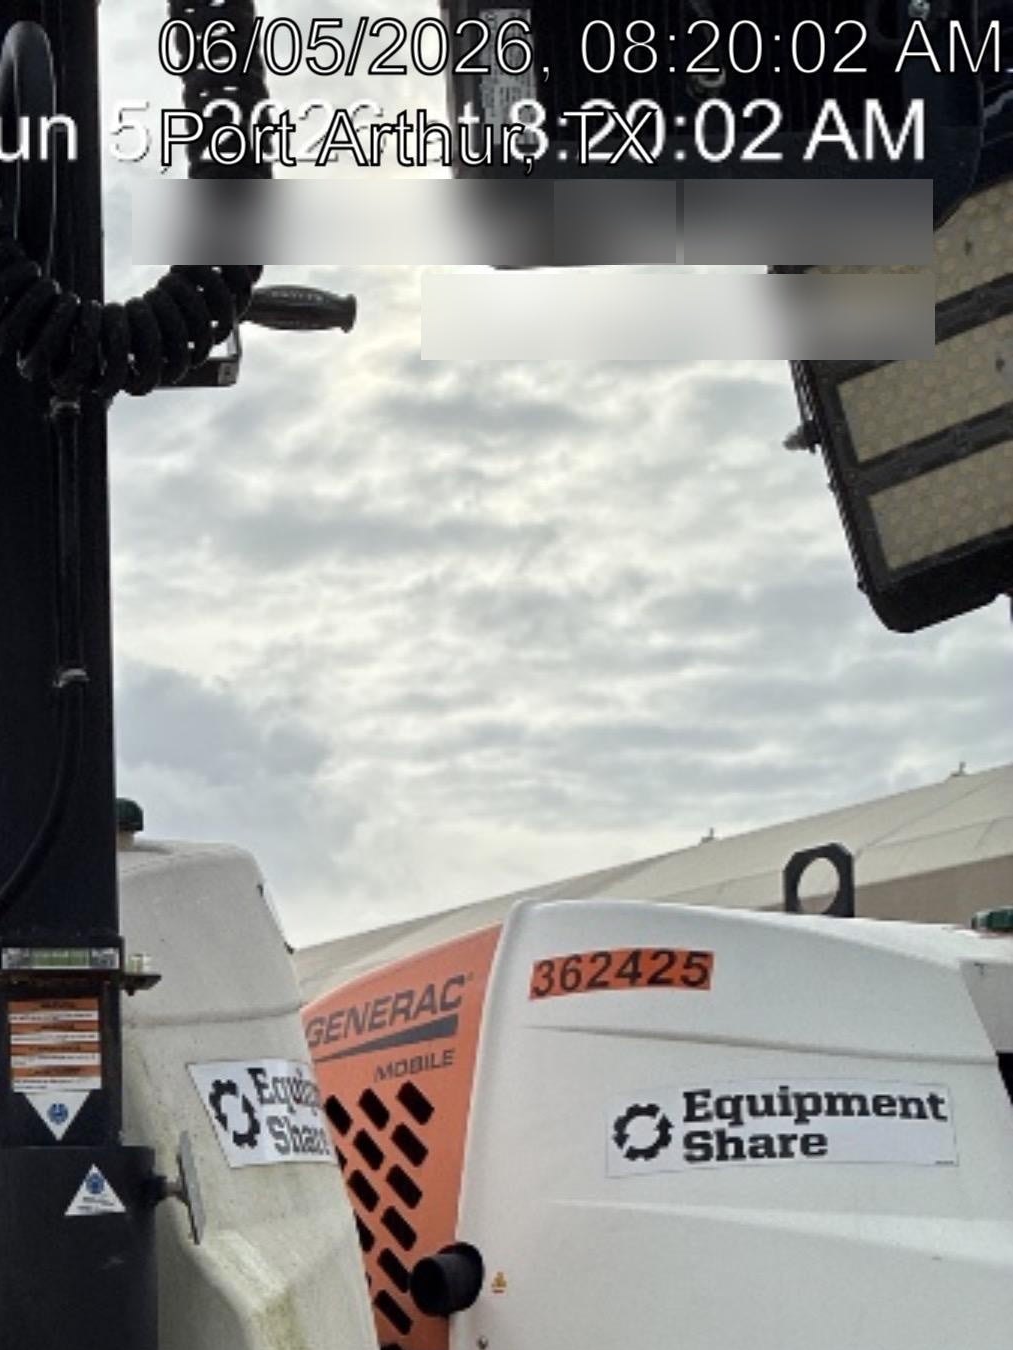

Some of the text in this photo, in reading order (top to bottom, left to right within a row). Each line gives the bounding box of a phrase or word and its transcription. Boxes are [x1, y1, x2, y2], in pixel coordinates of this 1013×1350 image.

[532, 948, 710, 998] 362425
[304, 973, 466, 1049] GENERAC
[374, 1049, 455, 1083] MOBILE
[683, 1085, 948, 1128] Equipment
[683, 1127, 829, 1164] Share
